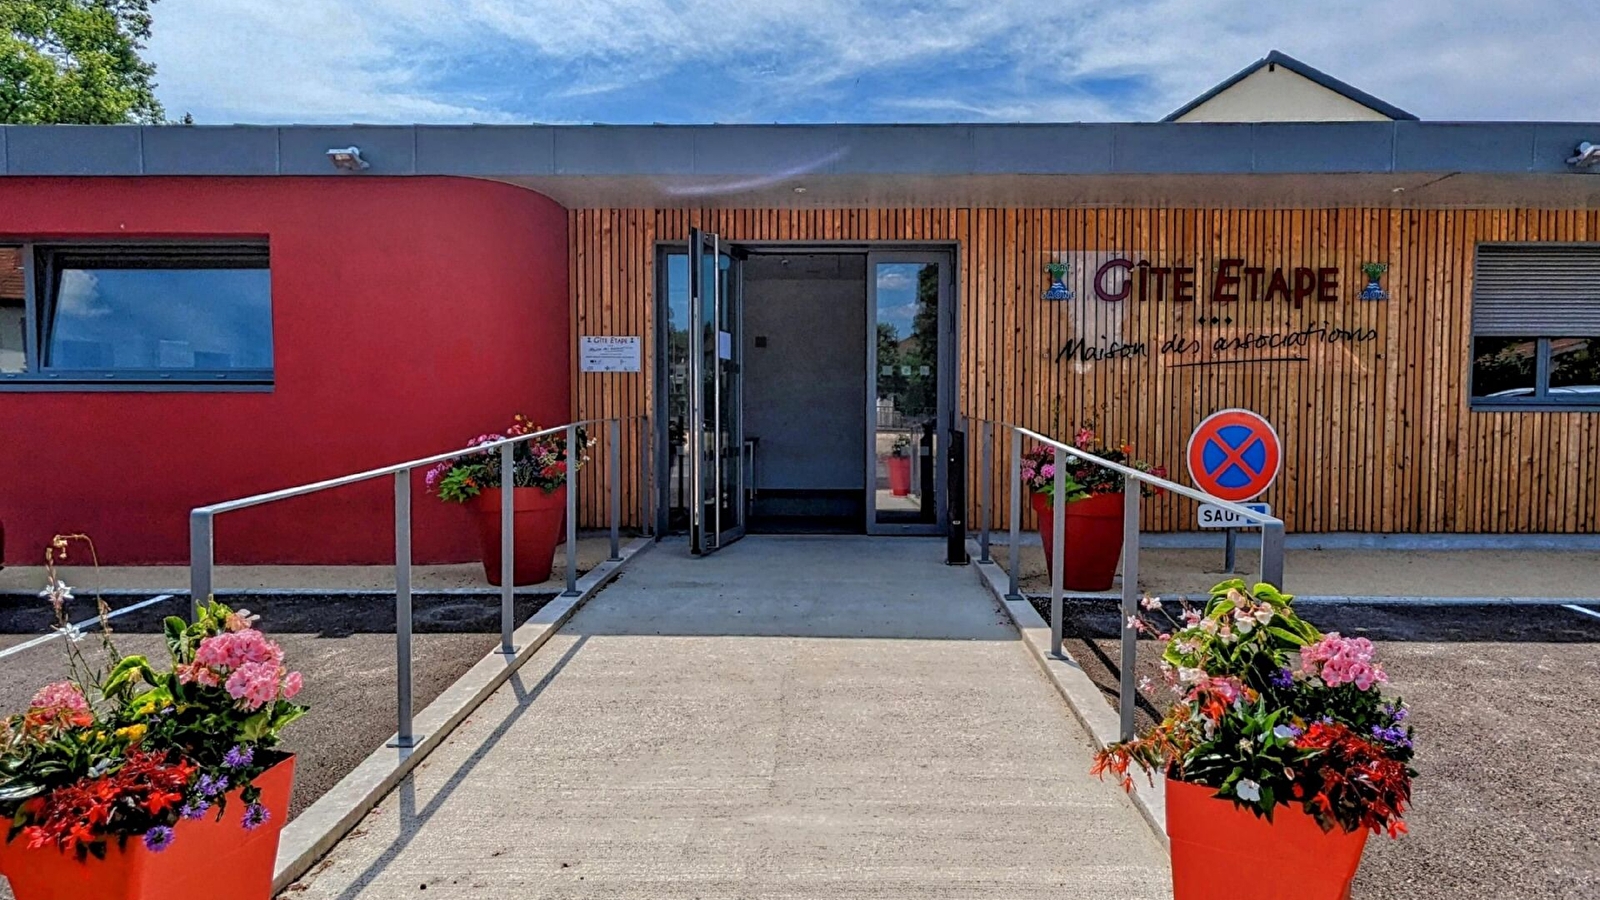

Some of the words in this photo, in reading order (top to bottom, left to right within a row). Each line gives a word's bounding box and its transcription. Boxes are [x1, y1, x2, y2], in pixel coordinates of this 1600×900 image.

[1094, 258, 1193, 301] GÎTE
[1213, 259, 1339, 309] ETAPE
[1055, 334, 1147, 363] Maison
[1161, 333, 1200, 355] des
[1213, 320, 1378, 351] associations
